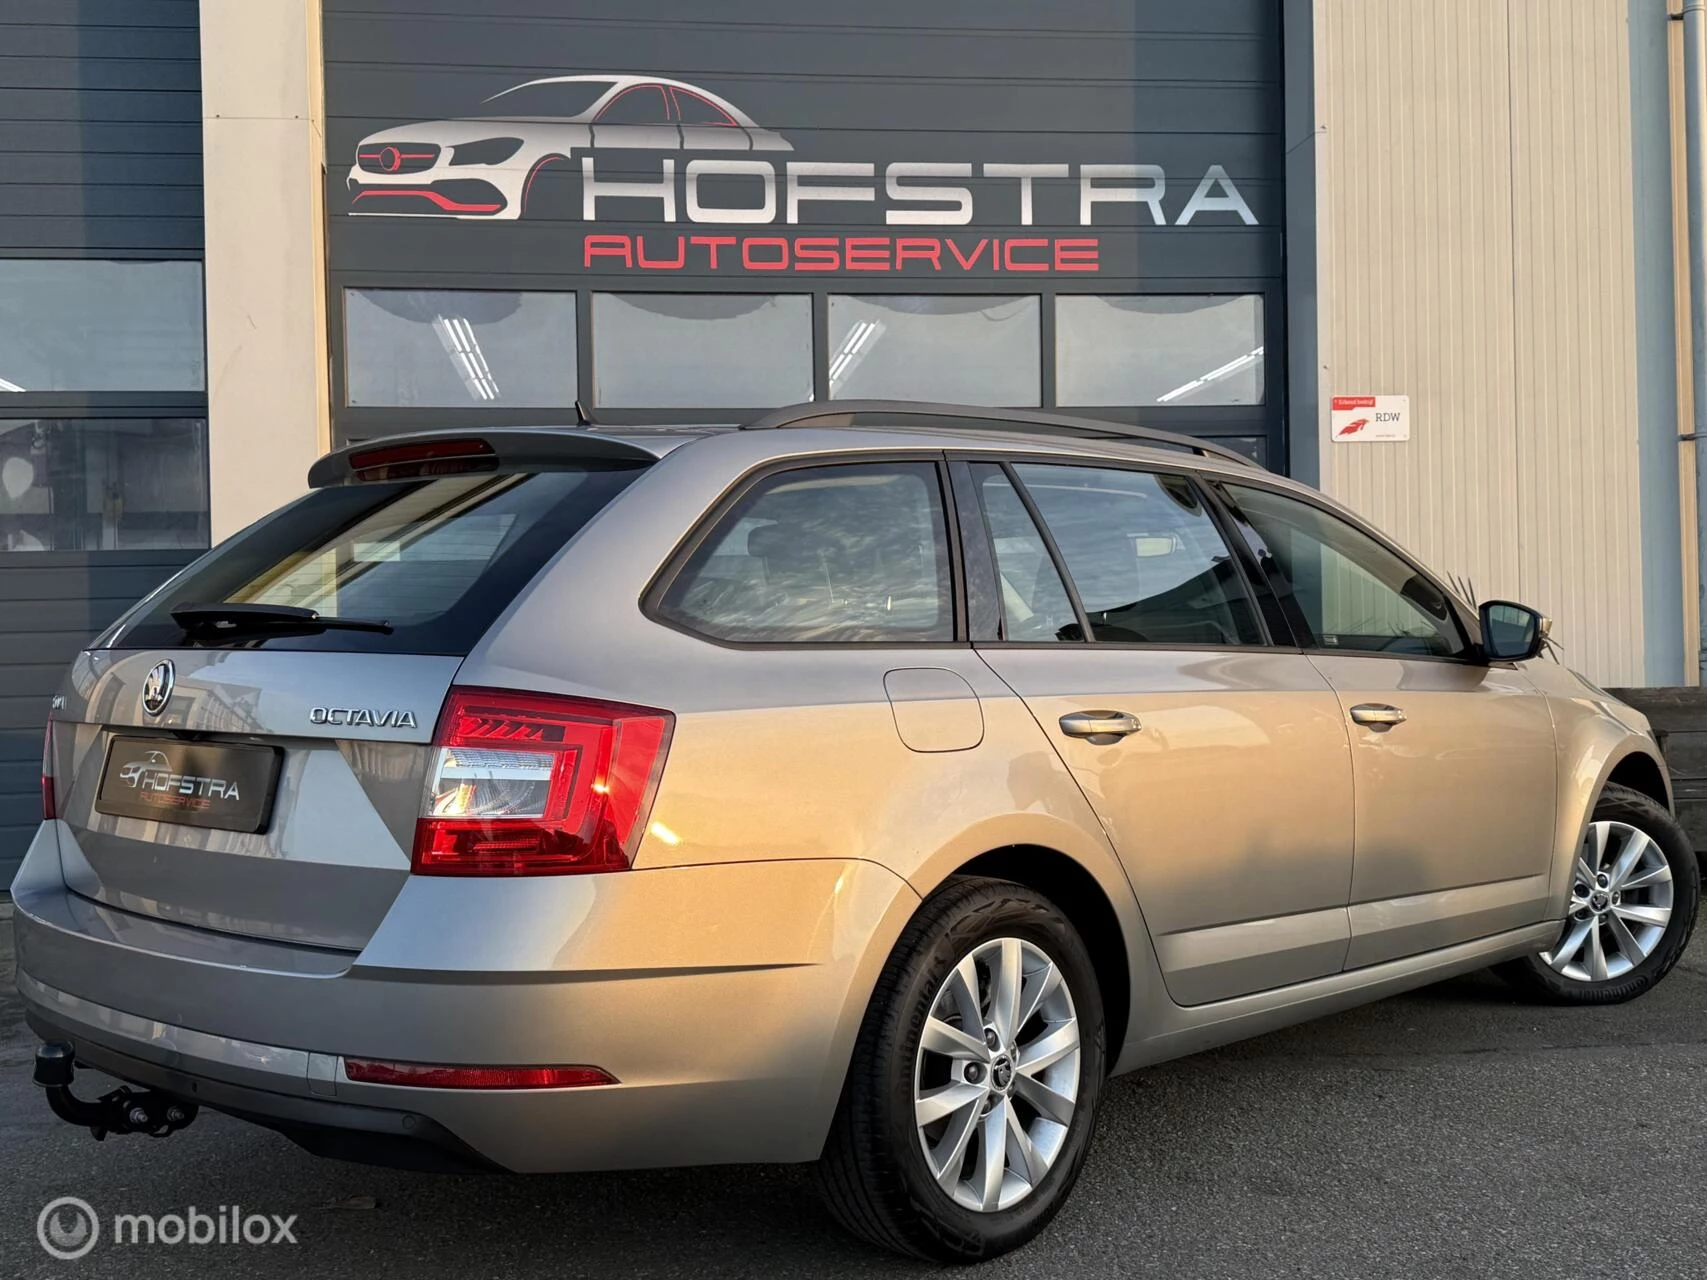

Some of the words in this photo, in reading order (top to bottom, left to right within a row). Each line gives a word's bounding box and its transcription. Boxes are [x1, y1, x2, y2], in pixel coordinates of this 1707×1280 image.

[581, 157, 1259, 225] HOFSTRA
[584, 234, 1099, 271] AUTOSERVICE
[1375, 412, 1401, 422] RDW
[310, 707, 417, 728] OCTAVIA
[142, 771, 240, 800] HOFSTRA
